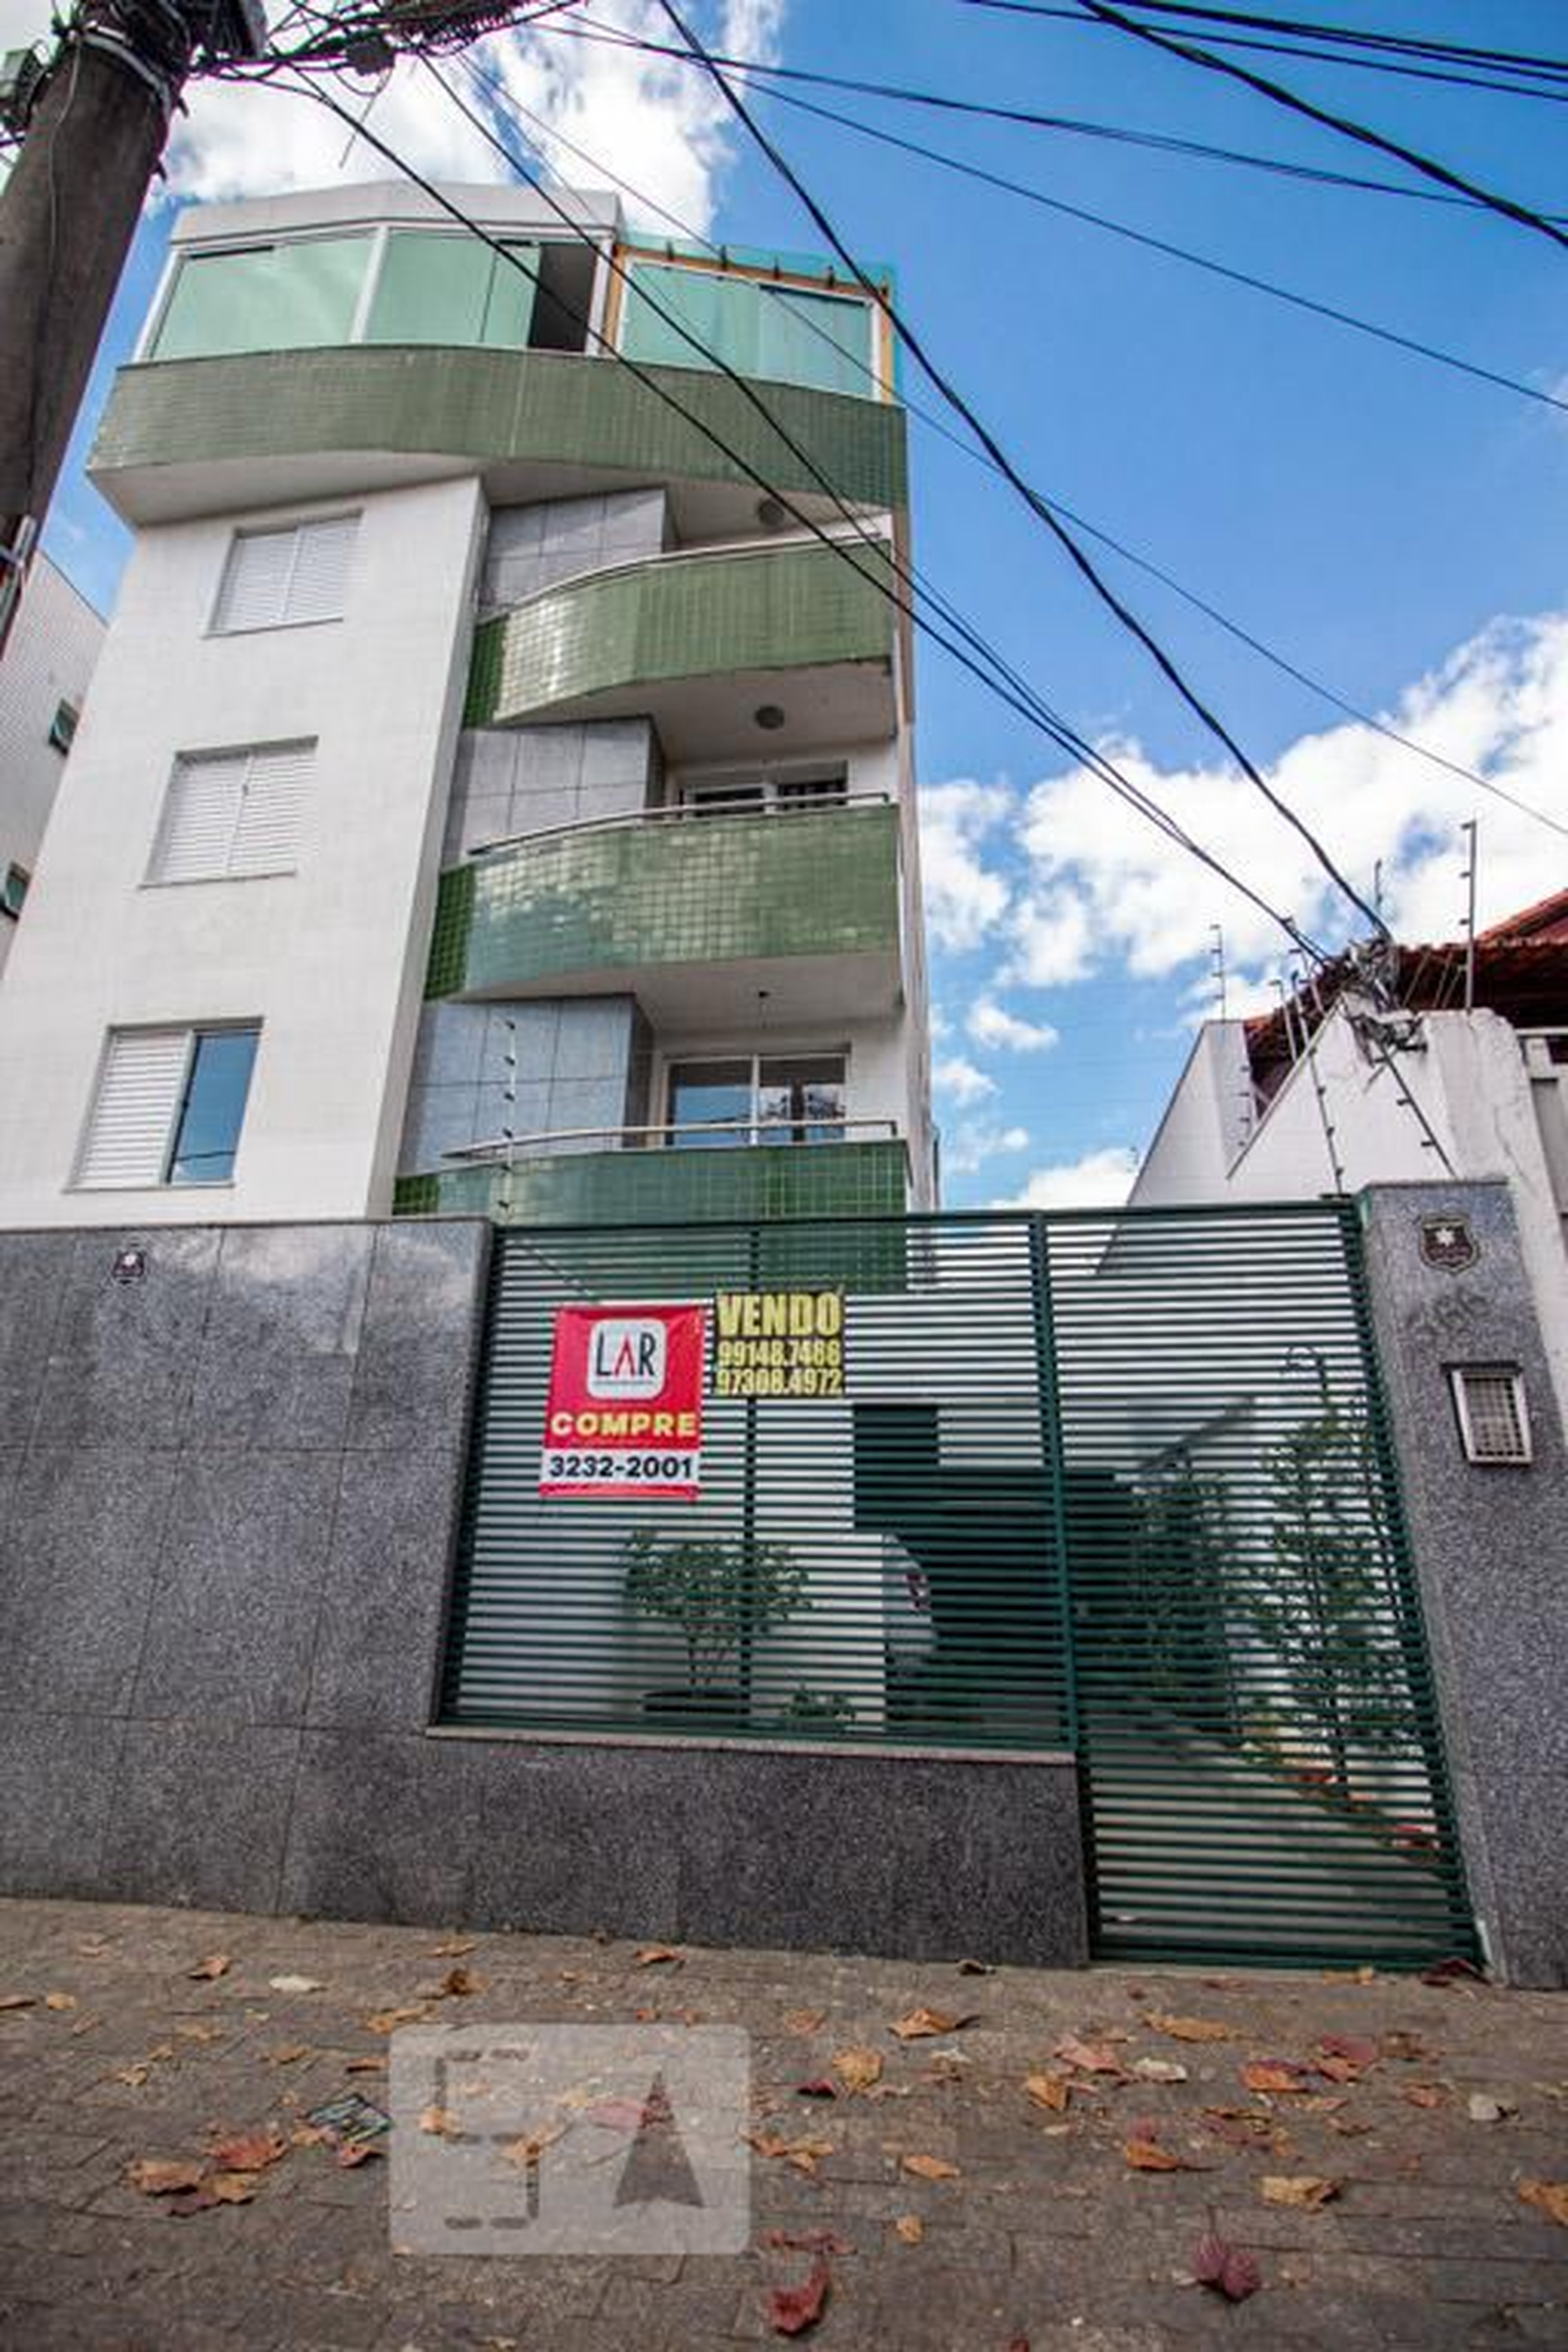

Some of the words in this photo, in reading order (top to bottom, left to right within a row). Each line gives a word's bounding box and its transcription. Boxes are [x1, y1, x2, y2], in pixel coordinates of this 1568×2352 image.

[717, 1292, 841, 1336] VENDO
[596, 1332, 656, 1376] LAR
[550, 1412, 696, 1436] COMPRE
[549, 1455, 692, 1478] 3232-2001
